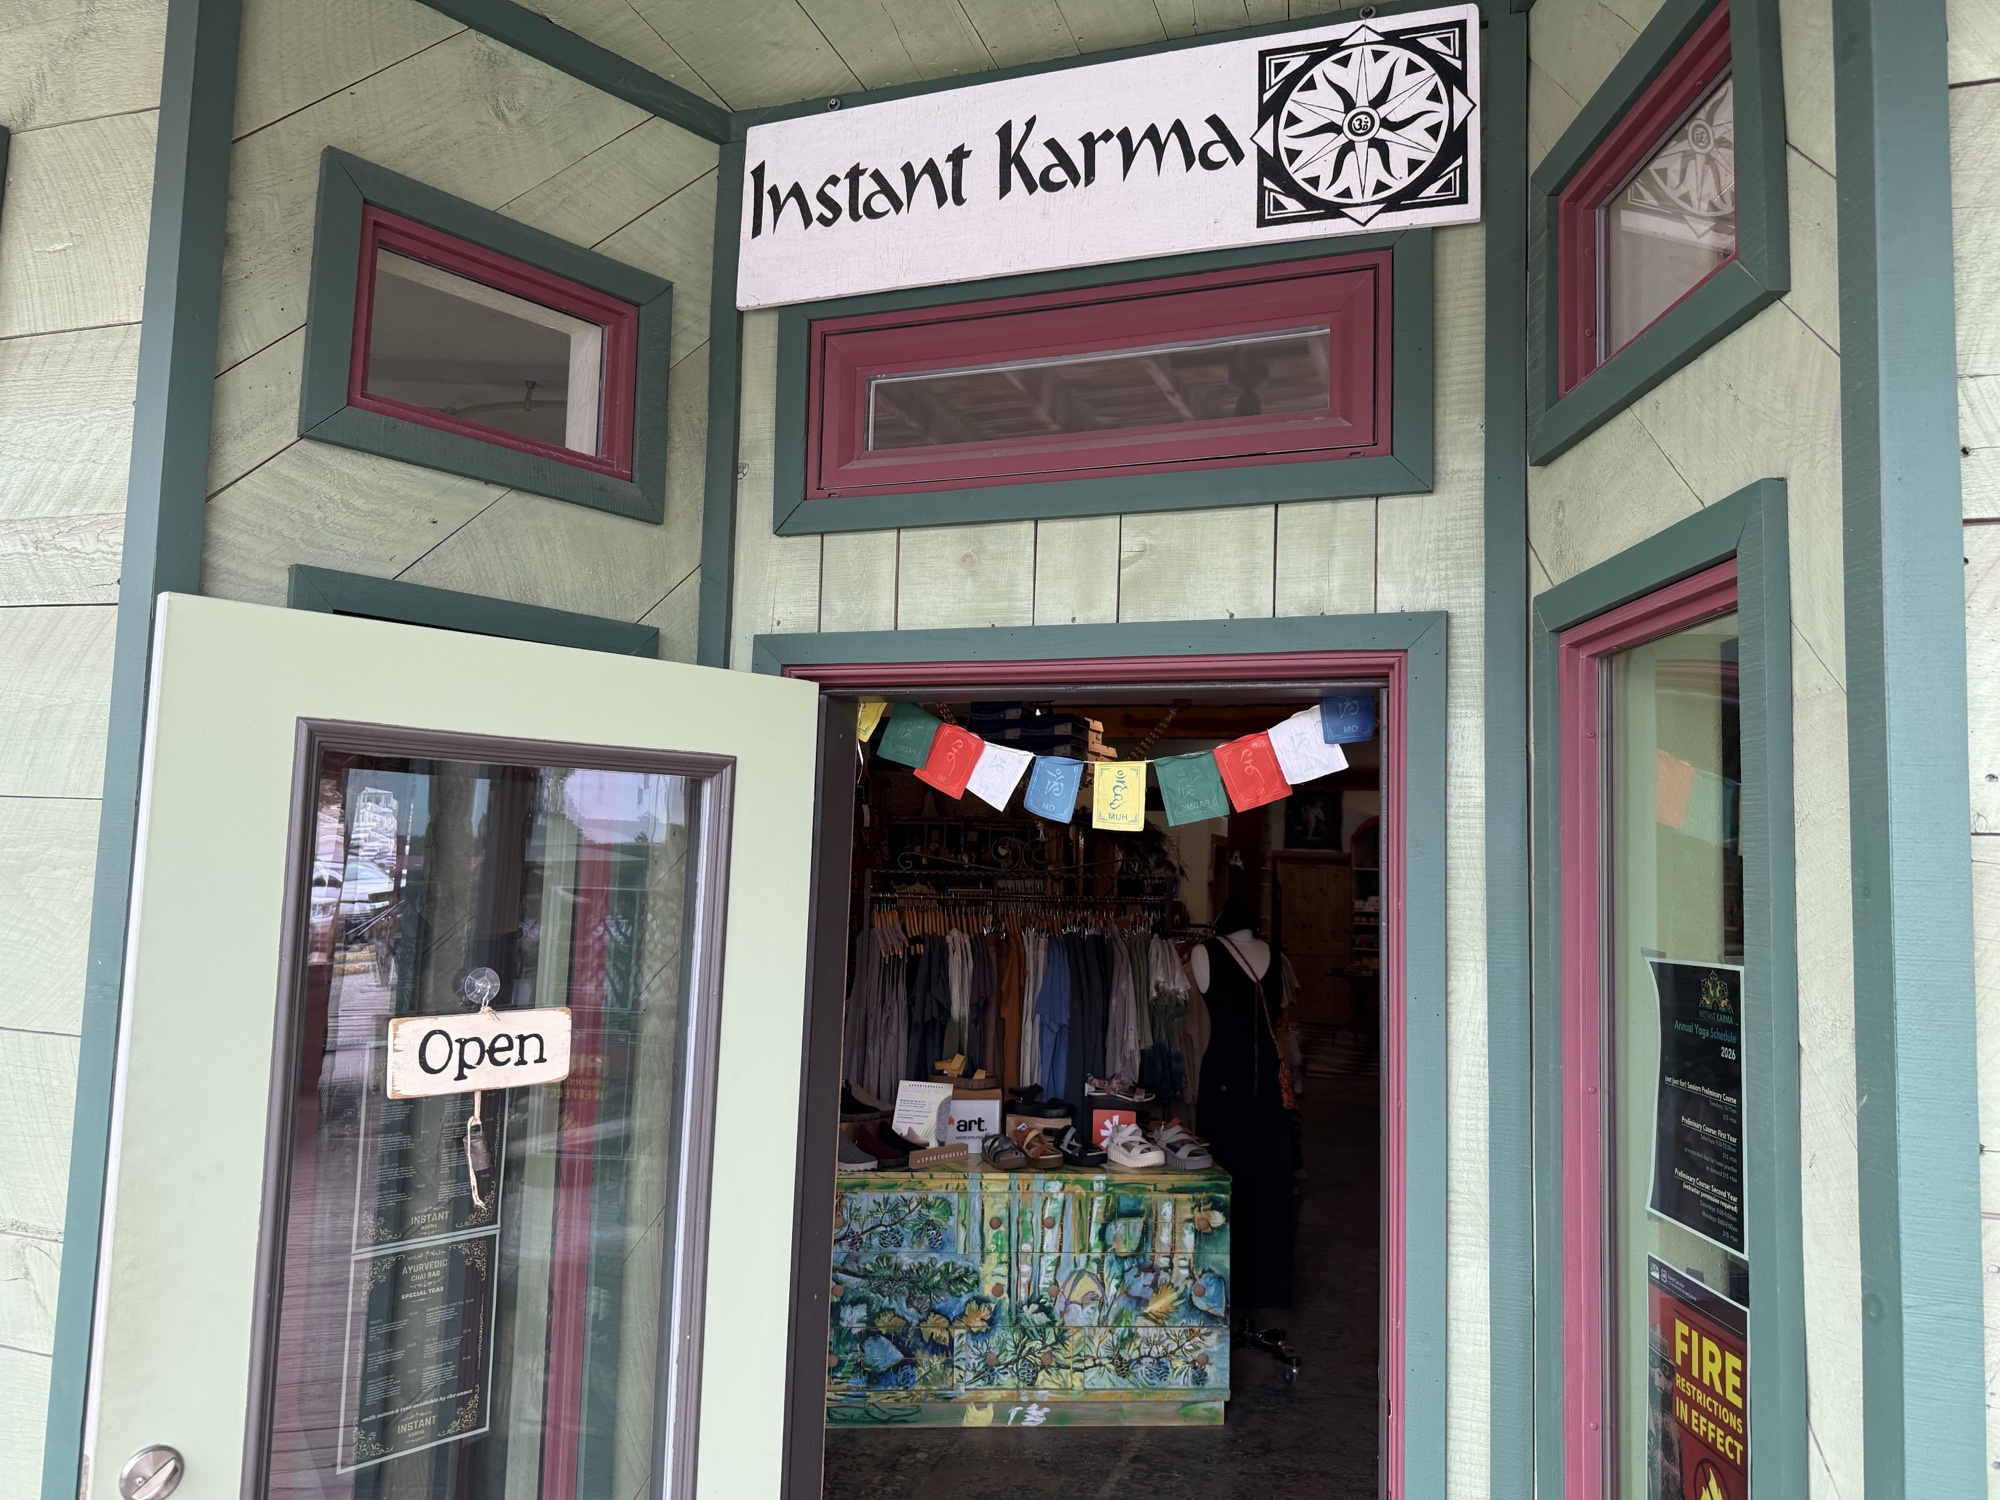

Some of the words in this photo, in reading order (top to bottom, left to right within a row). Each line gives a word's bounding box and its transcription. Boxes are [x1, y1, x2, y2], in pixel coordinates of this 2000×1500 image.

[750, 143, 973, 240] Instant
[996, 114, 1247, 200] Karma
[1674, 1019, 1693, 1033] Annual
[1694, 1024, 1709, 1039] Yoga
[1710, 1027, 1737, 1044] Schedule
[418, 1028, 547, 1082] Open
[1721, 1047, 1736, 1060] 2026
[1687, 1081, 1702, 1092] Seniors
[1702, 1086, 1722, 1101] Preliminary
[1722, 1093, 1737, 1105] Course
[1681, 1115, 1702, 1131] Preliminary
[1702, 1124, 1717, 1136] Course:
[1718, 1129, 1727, 1140] First
[1727, 1132, 1737, 1144] Year
[1674, 1168, 1695, 1185] Preliminary
[1695, 1177, 1711, 1191] Course:
[1711, 1184, 1726, 1198] Second
[1726, 1190, 1738, 1203] Year
[410, 1210, 450, 1225] INSTANT
[401, 1258, 448, 1275] AYURVEDIC
[410, 1272, 427, 1282] CHAI
[427, 1270, 441, 1280] BAR
[401, 1290, 427, 1300] SPECIAL
[428, 1286, 444, 1294] TEAS
[1674, 1318, 1742, 1410] FIRE
[1675, 1372, 1743, 1435] RESTRICTIONS
[397, 1415, 437, 1434] INSTANT
[1675, 1395, 1689, 1426] IN
[1691, 1412, 1743, 1466] EFFECT
